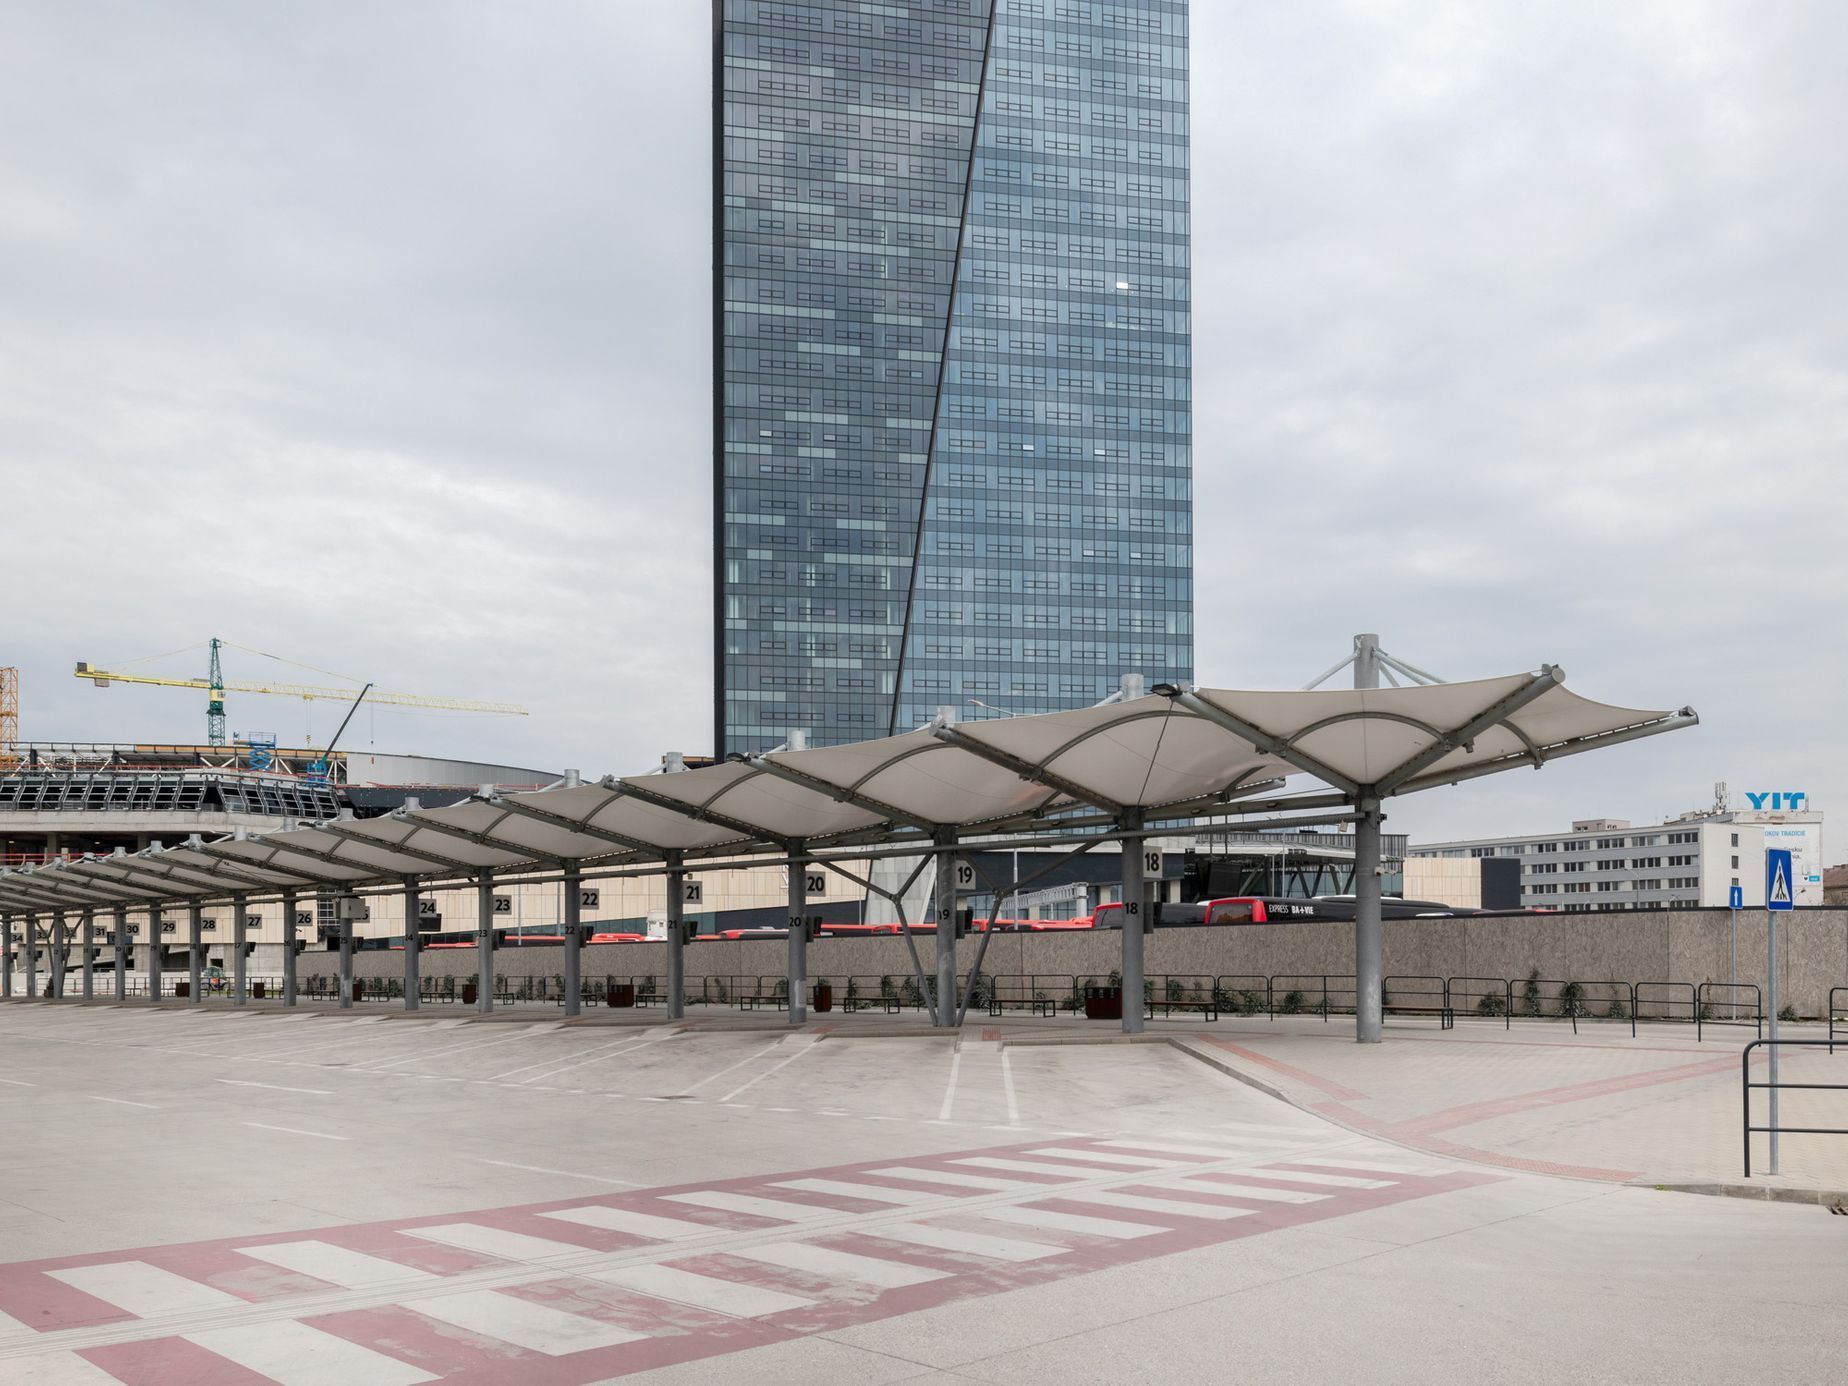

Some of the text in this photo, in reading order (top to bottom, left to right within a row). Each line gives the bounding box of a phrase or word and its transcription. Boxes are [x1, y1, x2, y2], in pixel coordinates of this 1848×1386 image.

[1744, 792, 1805, 810] YIT
[1144, 852, 1160, 872] 18
[957, 866, 973, 884] 19
[807, 876, 825, 892] 20
[686, 885, 700, 900] 21
[495, 898, 511, 911] 23
[581, 892, 598, 906] 22
[420, 902, 436, 914] 24
[938, 908, 950, 920] 19
[1125, 902, 1138, 915] 18
[1268, 904, 1289, 914] EXPRESS
[202, 919, 216, 929] 28
[248, 916, 262, 927] 27
[297, 913, 312, 924] 26
[667, 919, 677, 929] 21
[789, 916, 801, 928] 20
[95, 928, 105, 936] 31
[126, 925, 139, 934] 30
[162, 923, 175, 932] 29
